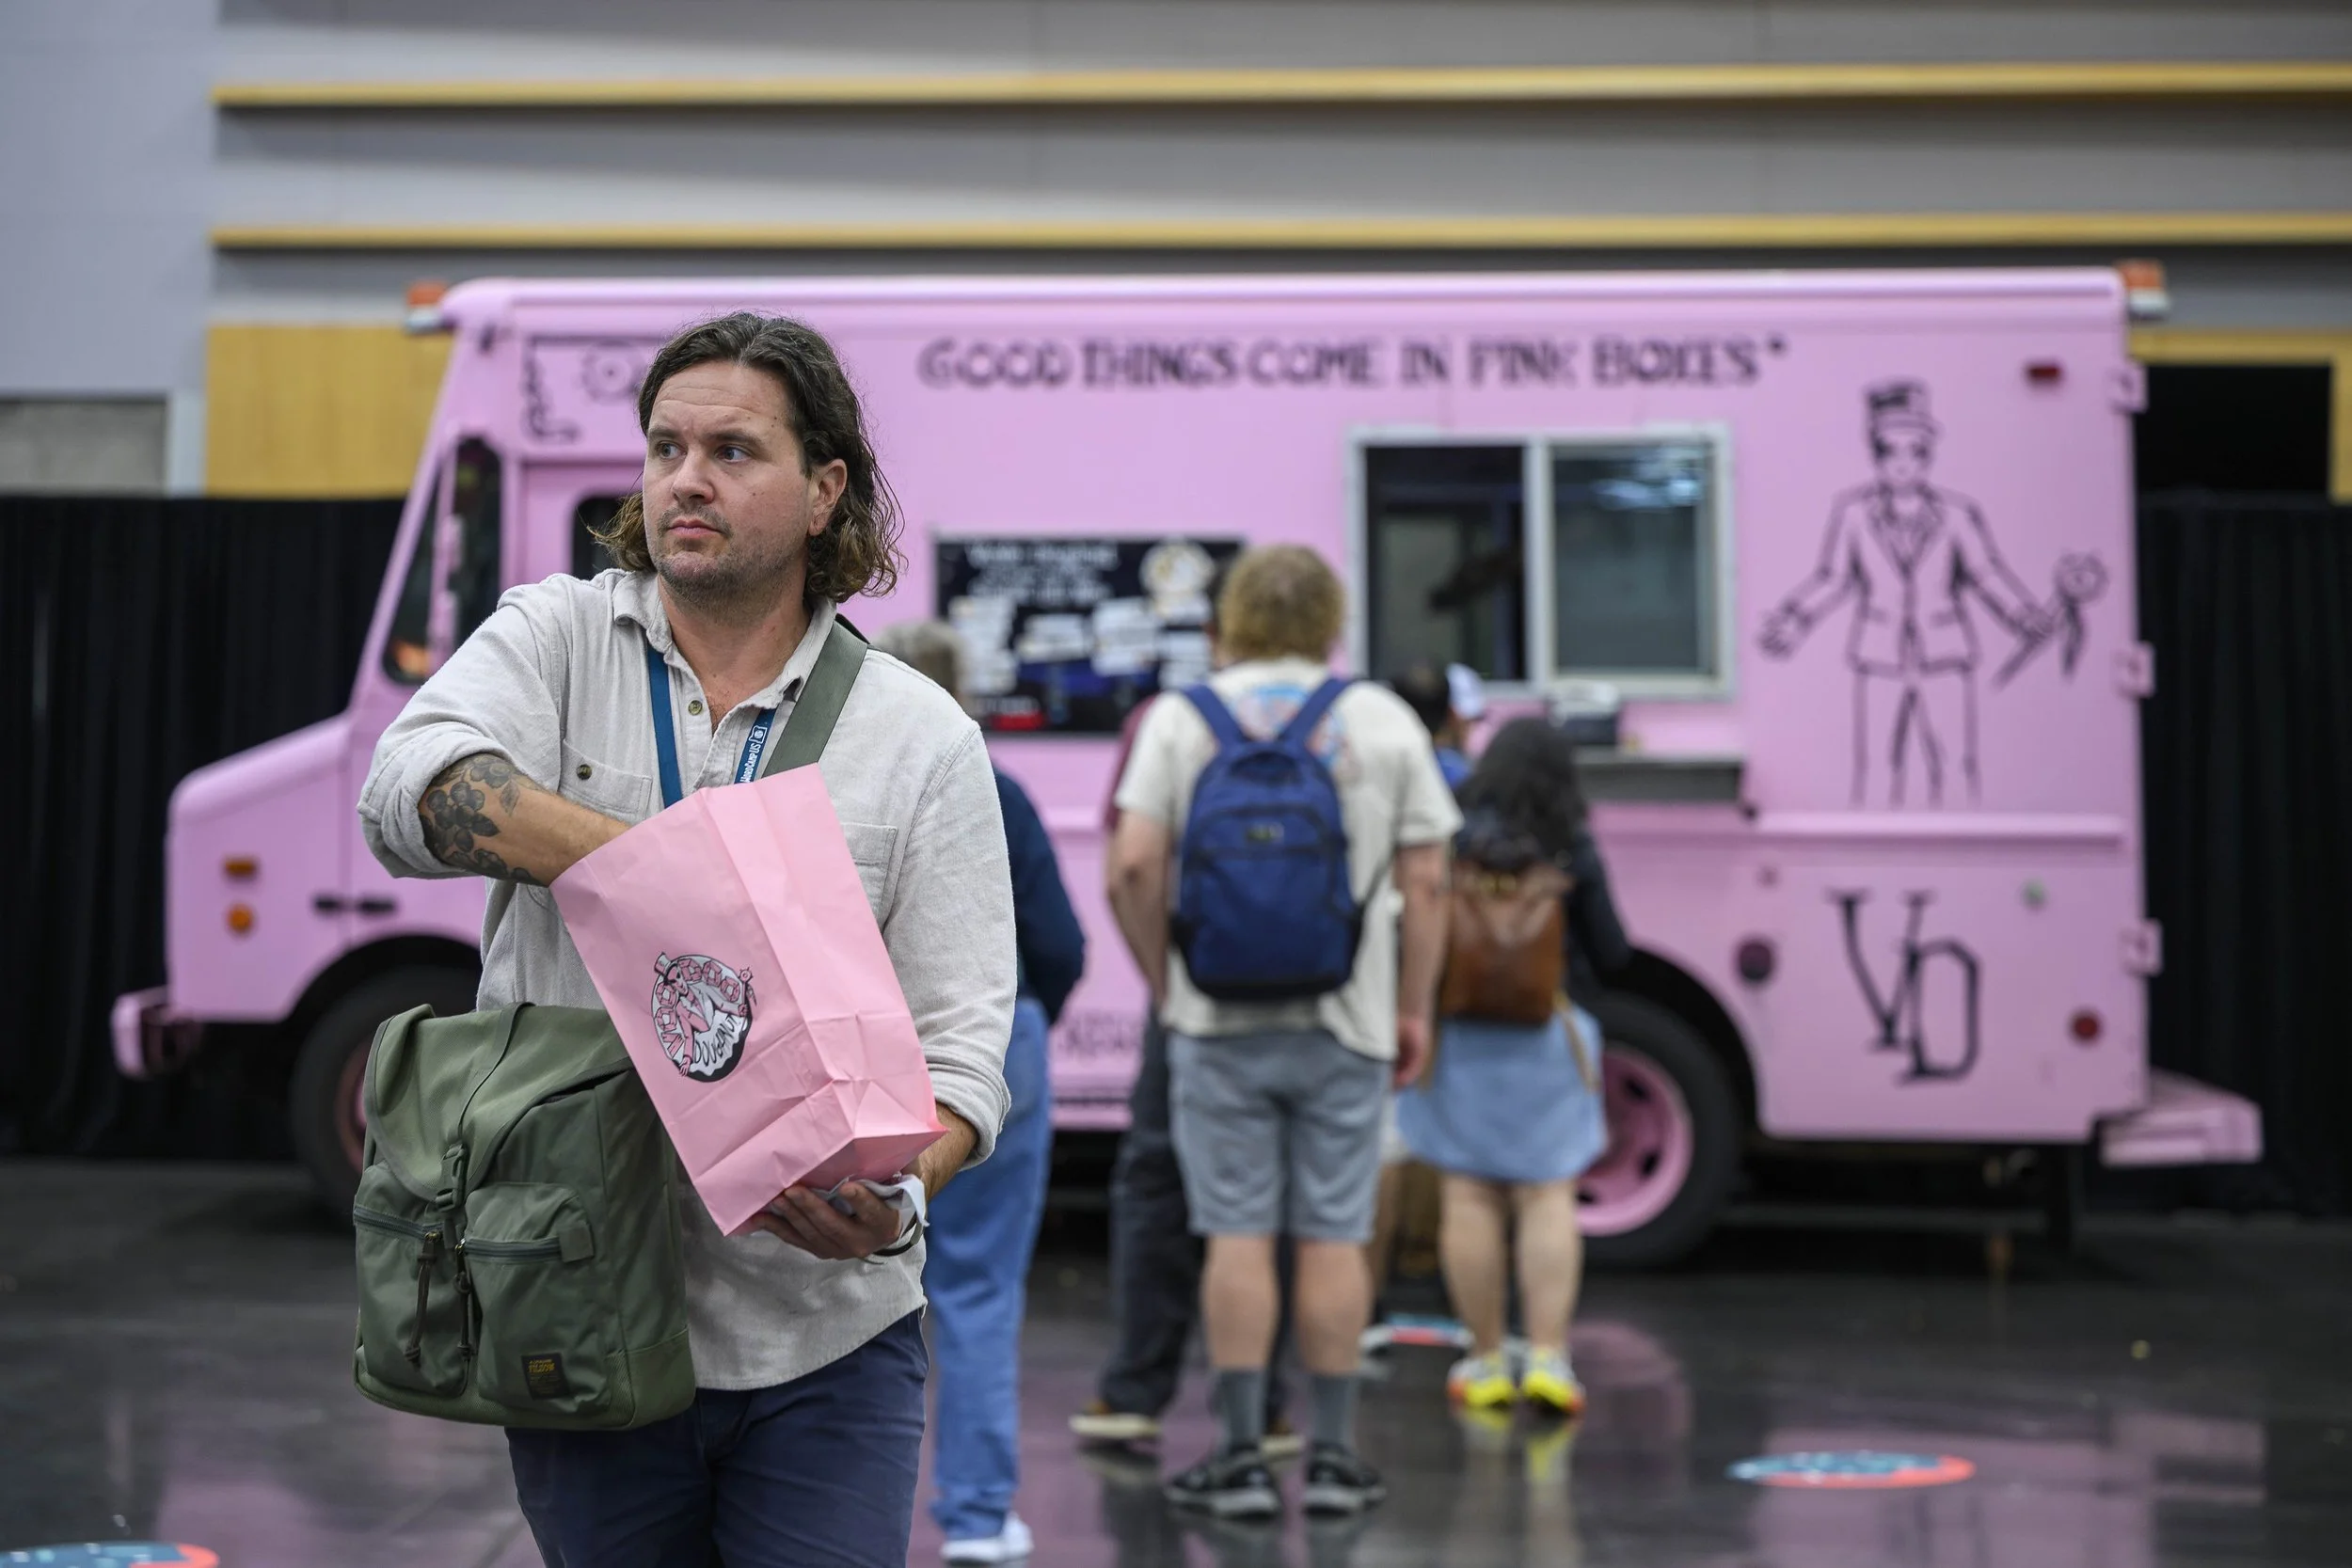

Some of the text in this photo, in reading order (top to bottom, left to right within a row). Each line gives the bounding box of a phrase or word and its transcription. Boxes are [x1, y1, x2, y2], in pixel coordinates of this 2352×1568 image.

[916, 336, 1074, 389] GOOD
[1082, 337, 1239, 388] THINGS
[1246, 338, 1383, 388] COME
[1401, 337, 1451, 388] IN
[1469, 337, 1579, 388] PINK
[749, 742, 761, 753] US
